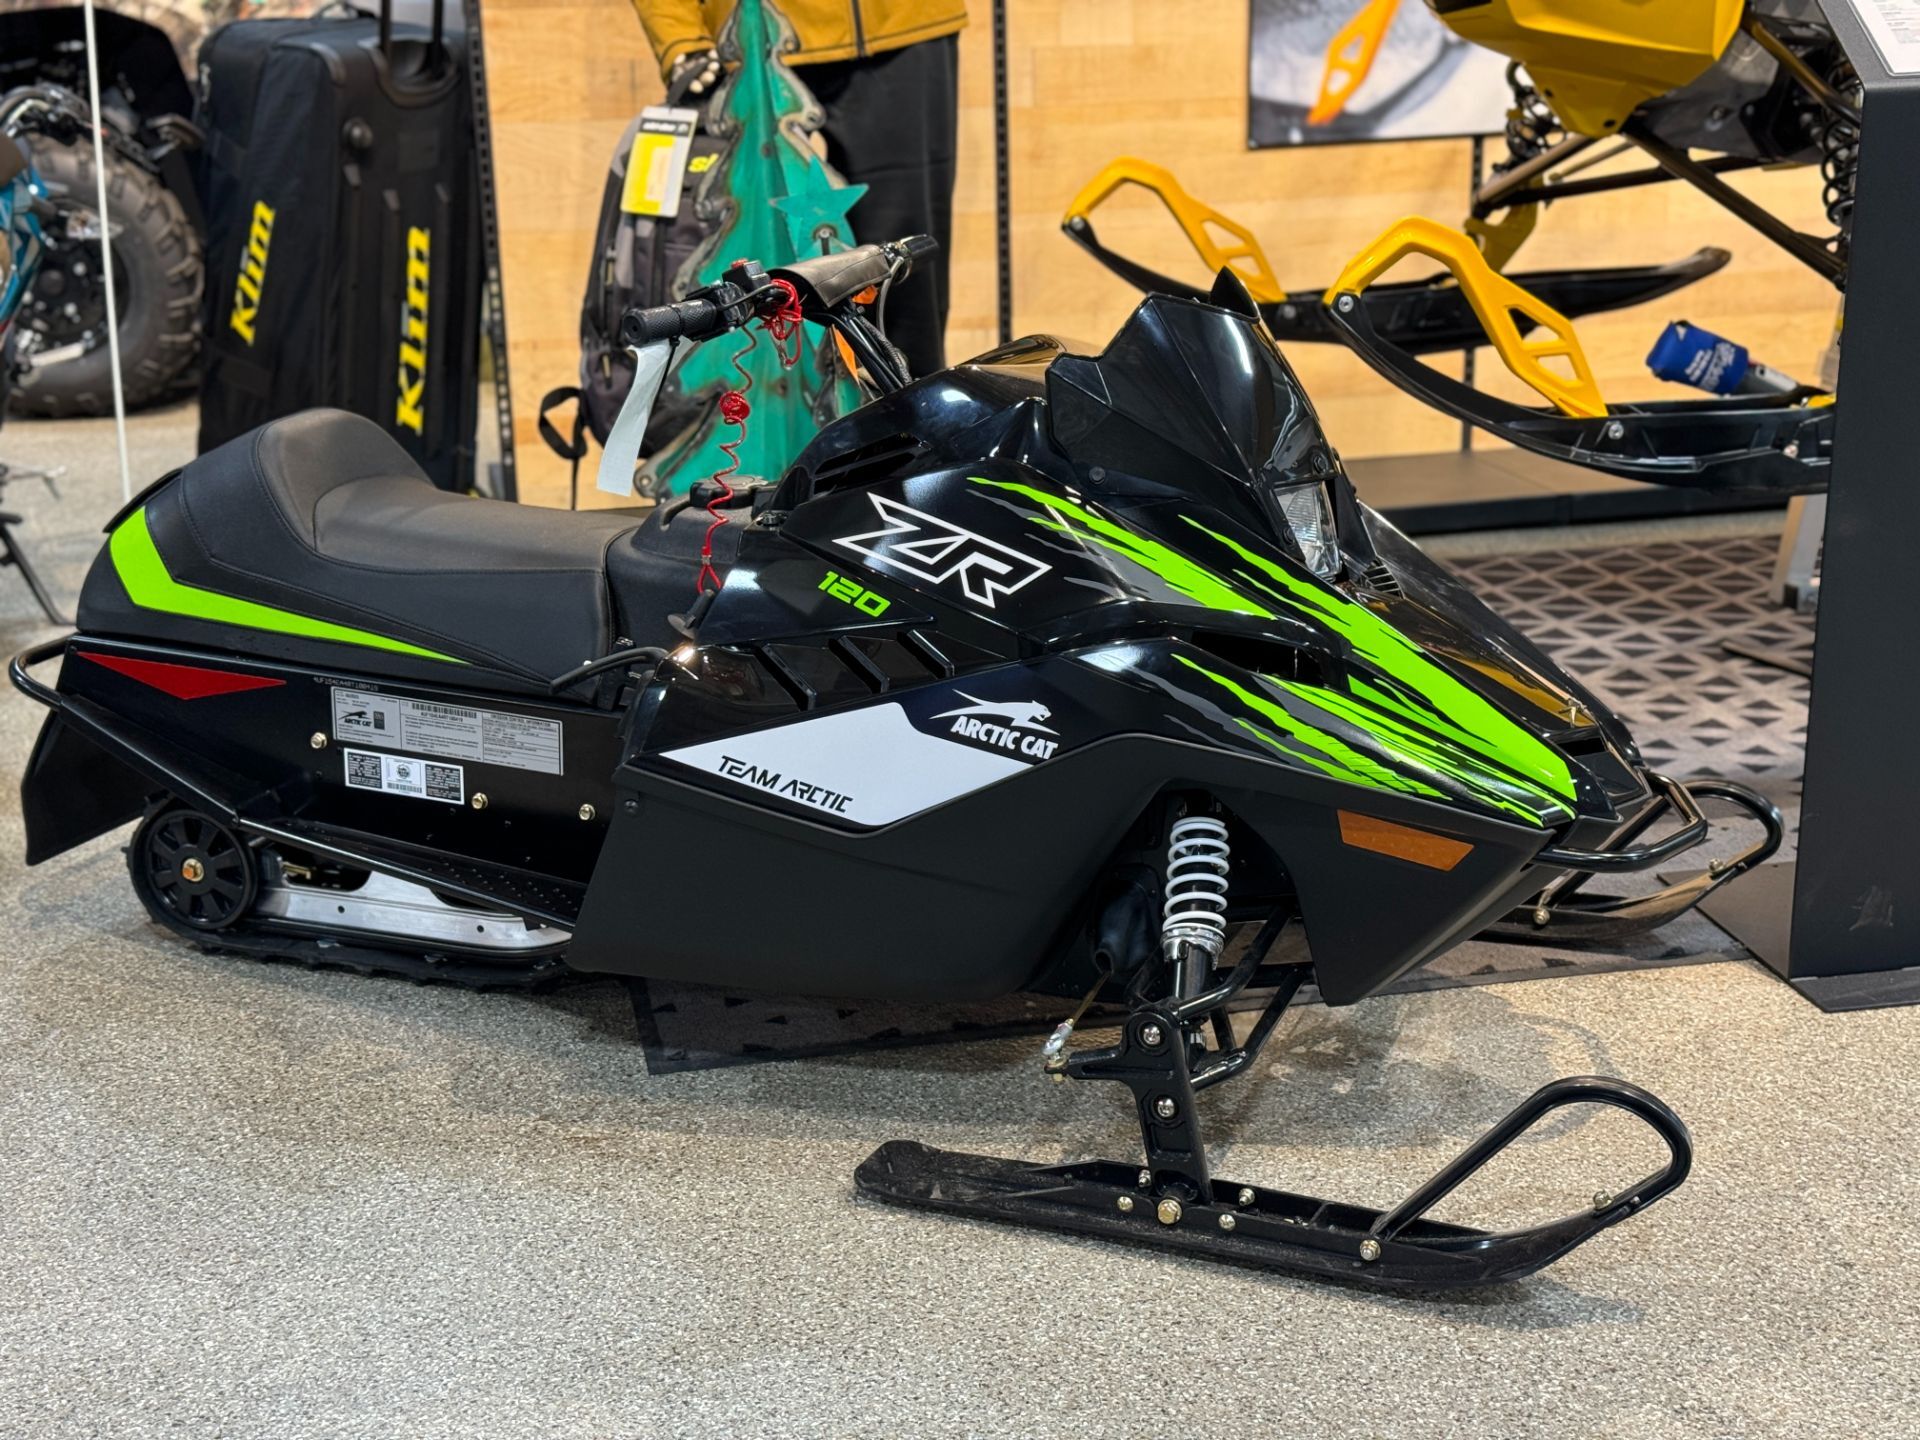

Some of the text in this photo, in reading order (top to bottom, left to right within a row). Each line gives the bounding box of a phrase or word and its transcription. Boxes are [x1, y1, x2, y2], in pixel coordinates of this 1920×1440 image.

[832, 492, 1053, 608] ZR
[818, 570, 891, 618] 120
[950, 715, 1060, 760] ARCTIC CAT
[717, 755, 853, 814] TEAM ARCTIC
